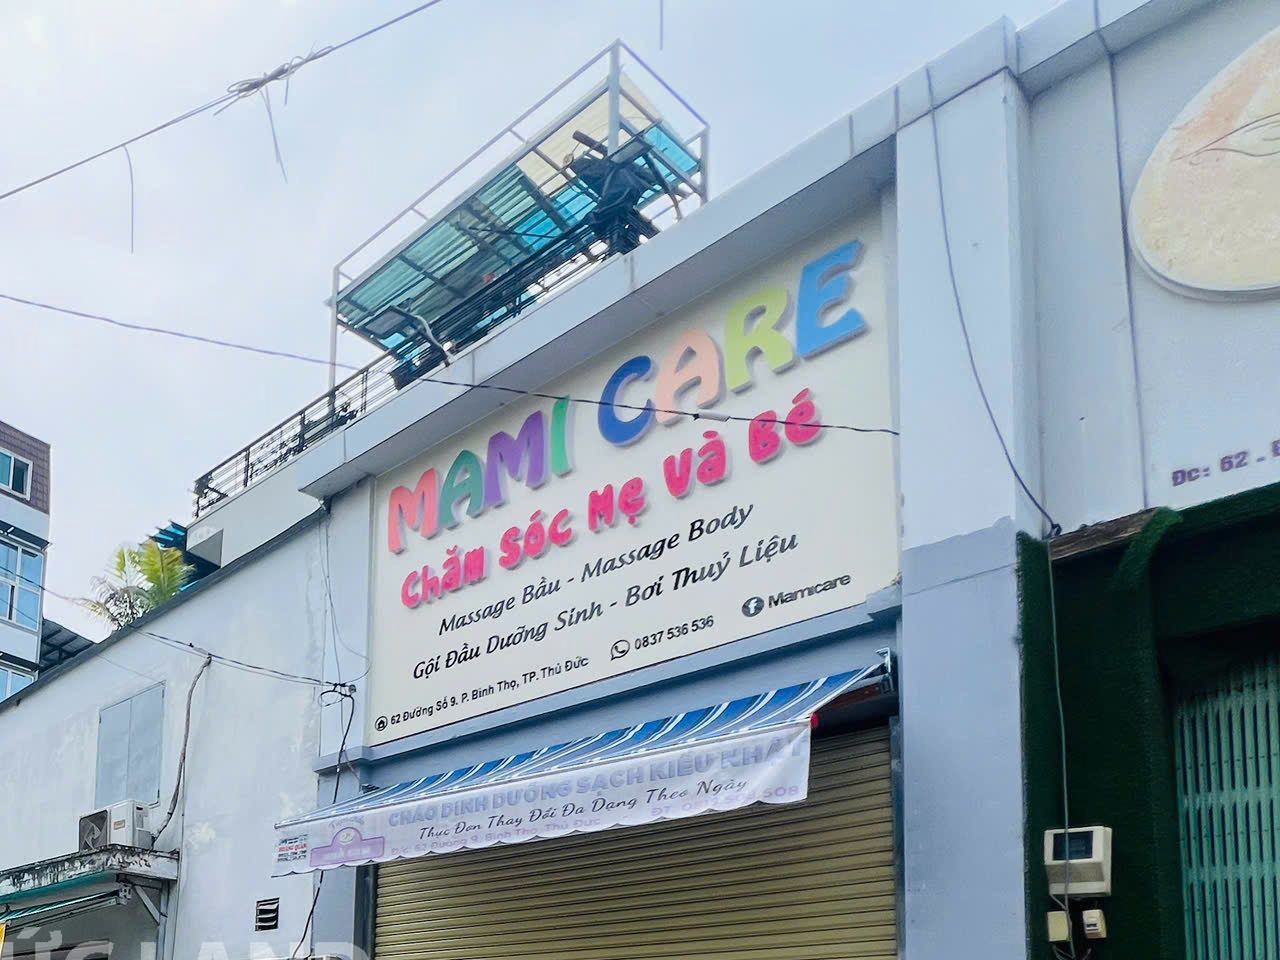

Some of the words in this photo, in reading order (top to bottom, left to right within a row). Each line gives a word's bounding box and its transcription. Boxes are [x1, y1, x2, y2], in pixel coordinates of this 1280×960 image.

[386, 395, 575, 554] MAMI
[596, 239, 870, 448] CARE
[1220, 451, 1249, 472] 62
[439, 596, 516, 636] Massage
[521, 576, 561, 605] Bầu
[581, 533, 680, 582] Massage
[688, 504, 754, 542] Body
[768, 573, 853, 609] Mamicare
[413, 656, 441, 680] Gội
[445, 643, 481, 669] Đầu
[486, 622, 549, 655] Dưỡng
[554, 601, 604, 632] Sinh
[625, 575, 664, 607] Bơi
[739, 534, 799, 568] Liệu
[634, 631, 664, 651] 0837
[666, 622, 689, 641] 536
[691, 615, 715, 633] 536
[390, 714, 401, 725] 62
[435, 697, 448, 711] Số
[497, 680, 520, 692] Thọ,
[522, 672, 539, 684] TP.
[541, 663, 562, 679] Thủ
[564, 656, 590, 672] Đức
[487, 814, 524, 829] Thay
[561, 802, 585, 817] Đa
[591, 797, 638, 813] Dạng
[646, 787, 688, 803] Theo
[696, 779, 750, 796] Ngày
